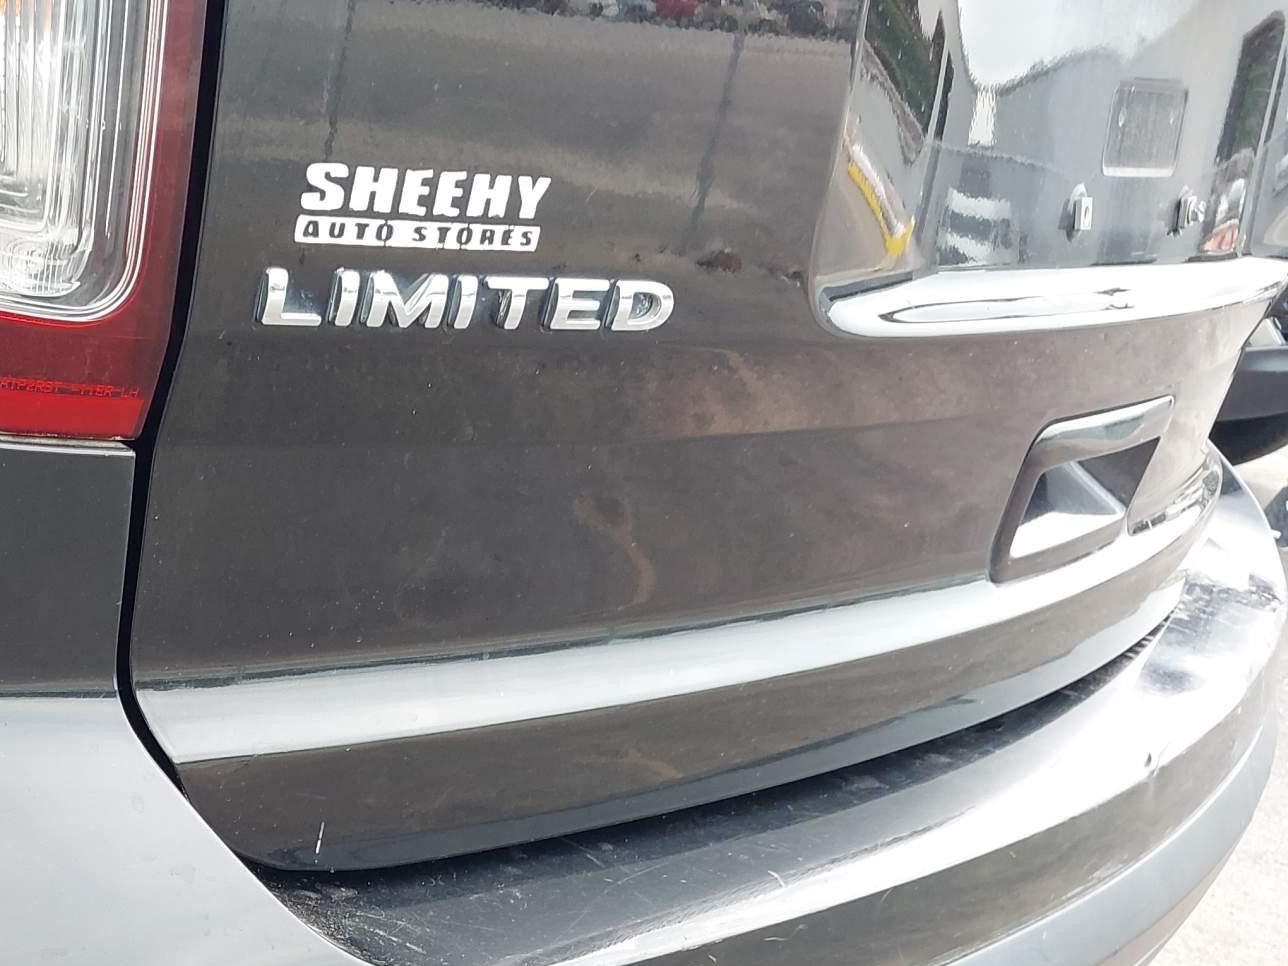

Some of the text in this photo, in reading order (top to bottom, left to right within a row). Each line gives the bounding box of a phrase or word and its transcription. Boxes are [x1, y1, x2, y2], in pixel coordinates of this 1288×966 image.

[300, 162, 552, 219] SHEEHY
[302, 219, 534, 247] AUTO STORES
[258, 266, 676, 331] LIMITED
